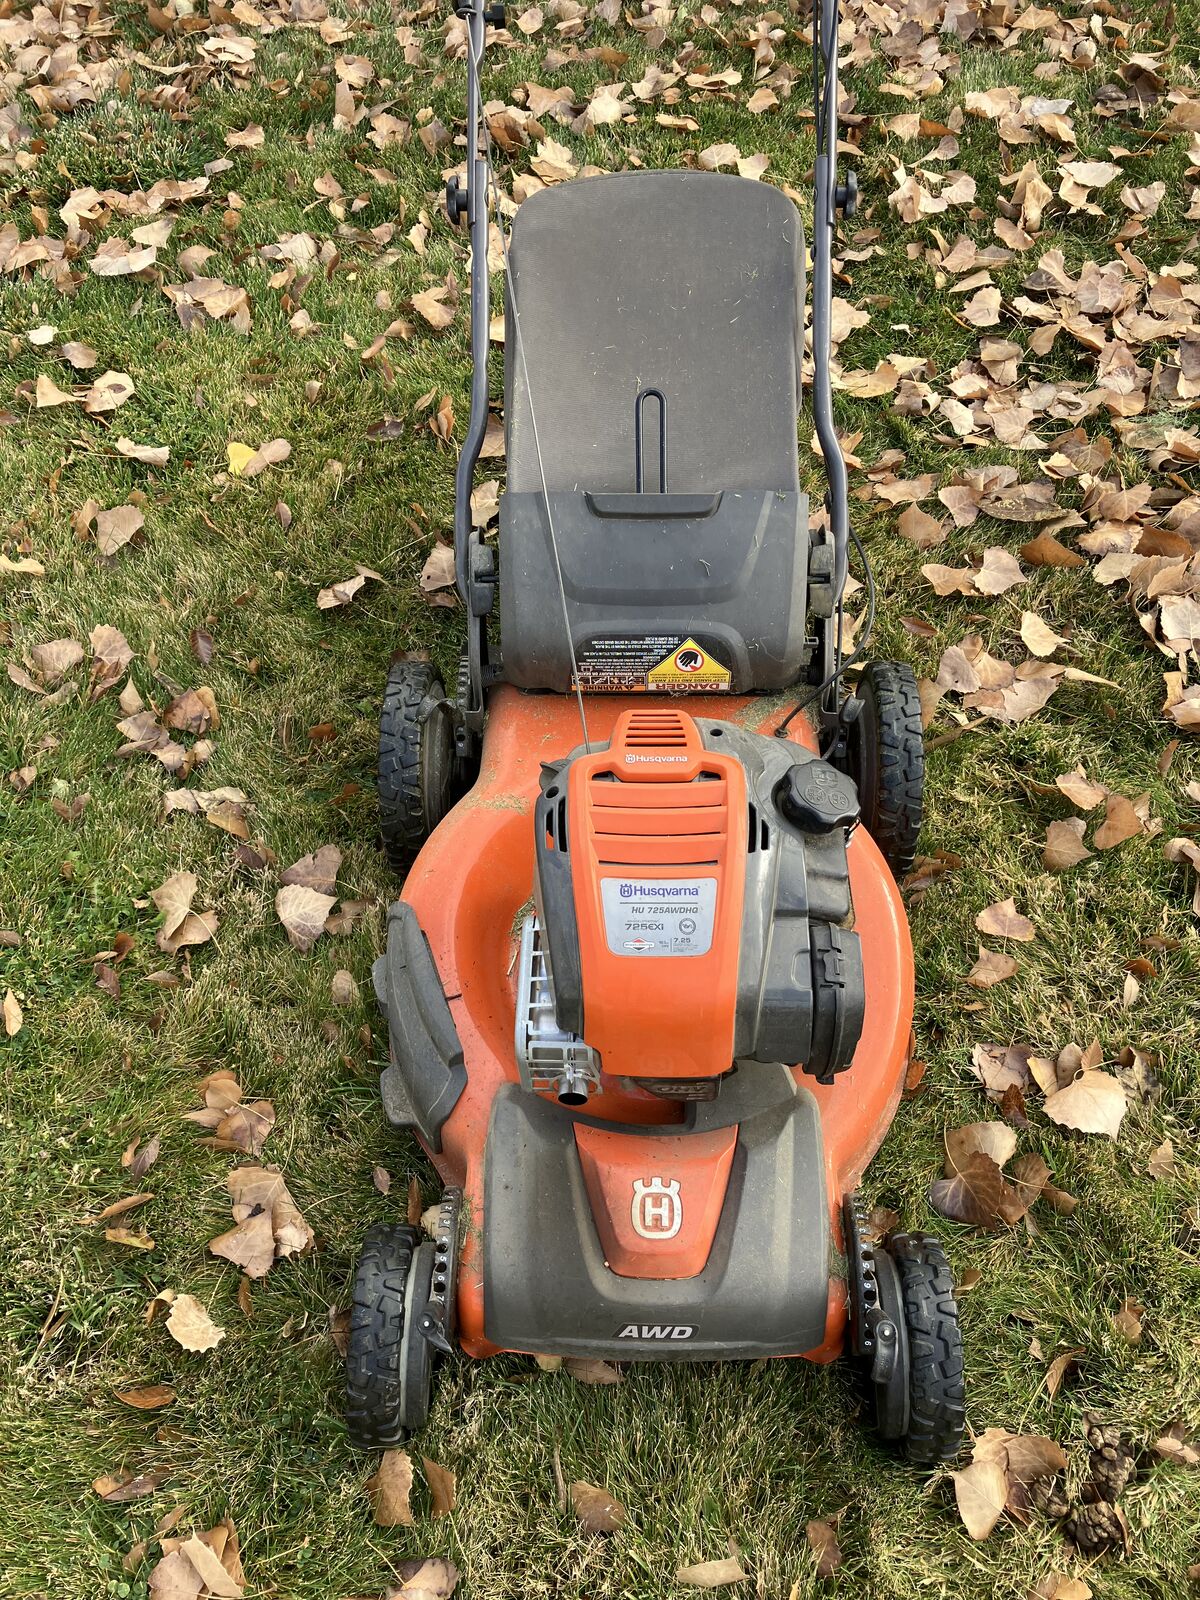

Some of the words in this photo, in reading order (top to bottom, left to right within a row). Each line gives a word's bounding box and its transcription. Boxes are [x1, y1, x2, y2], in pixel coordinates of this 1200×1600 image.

[636, 755, 688, 763] Husqvarna
[634, 886, 699, 898] Husqvarna
[618, 1325, 693, 1339] AWD
